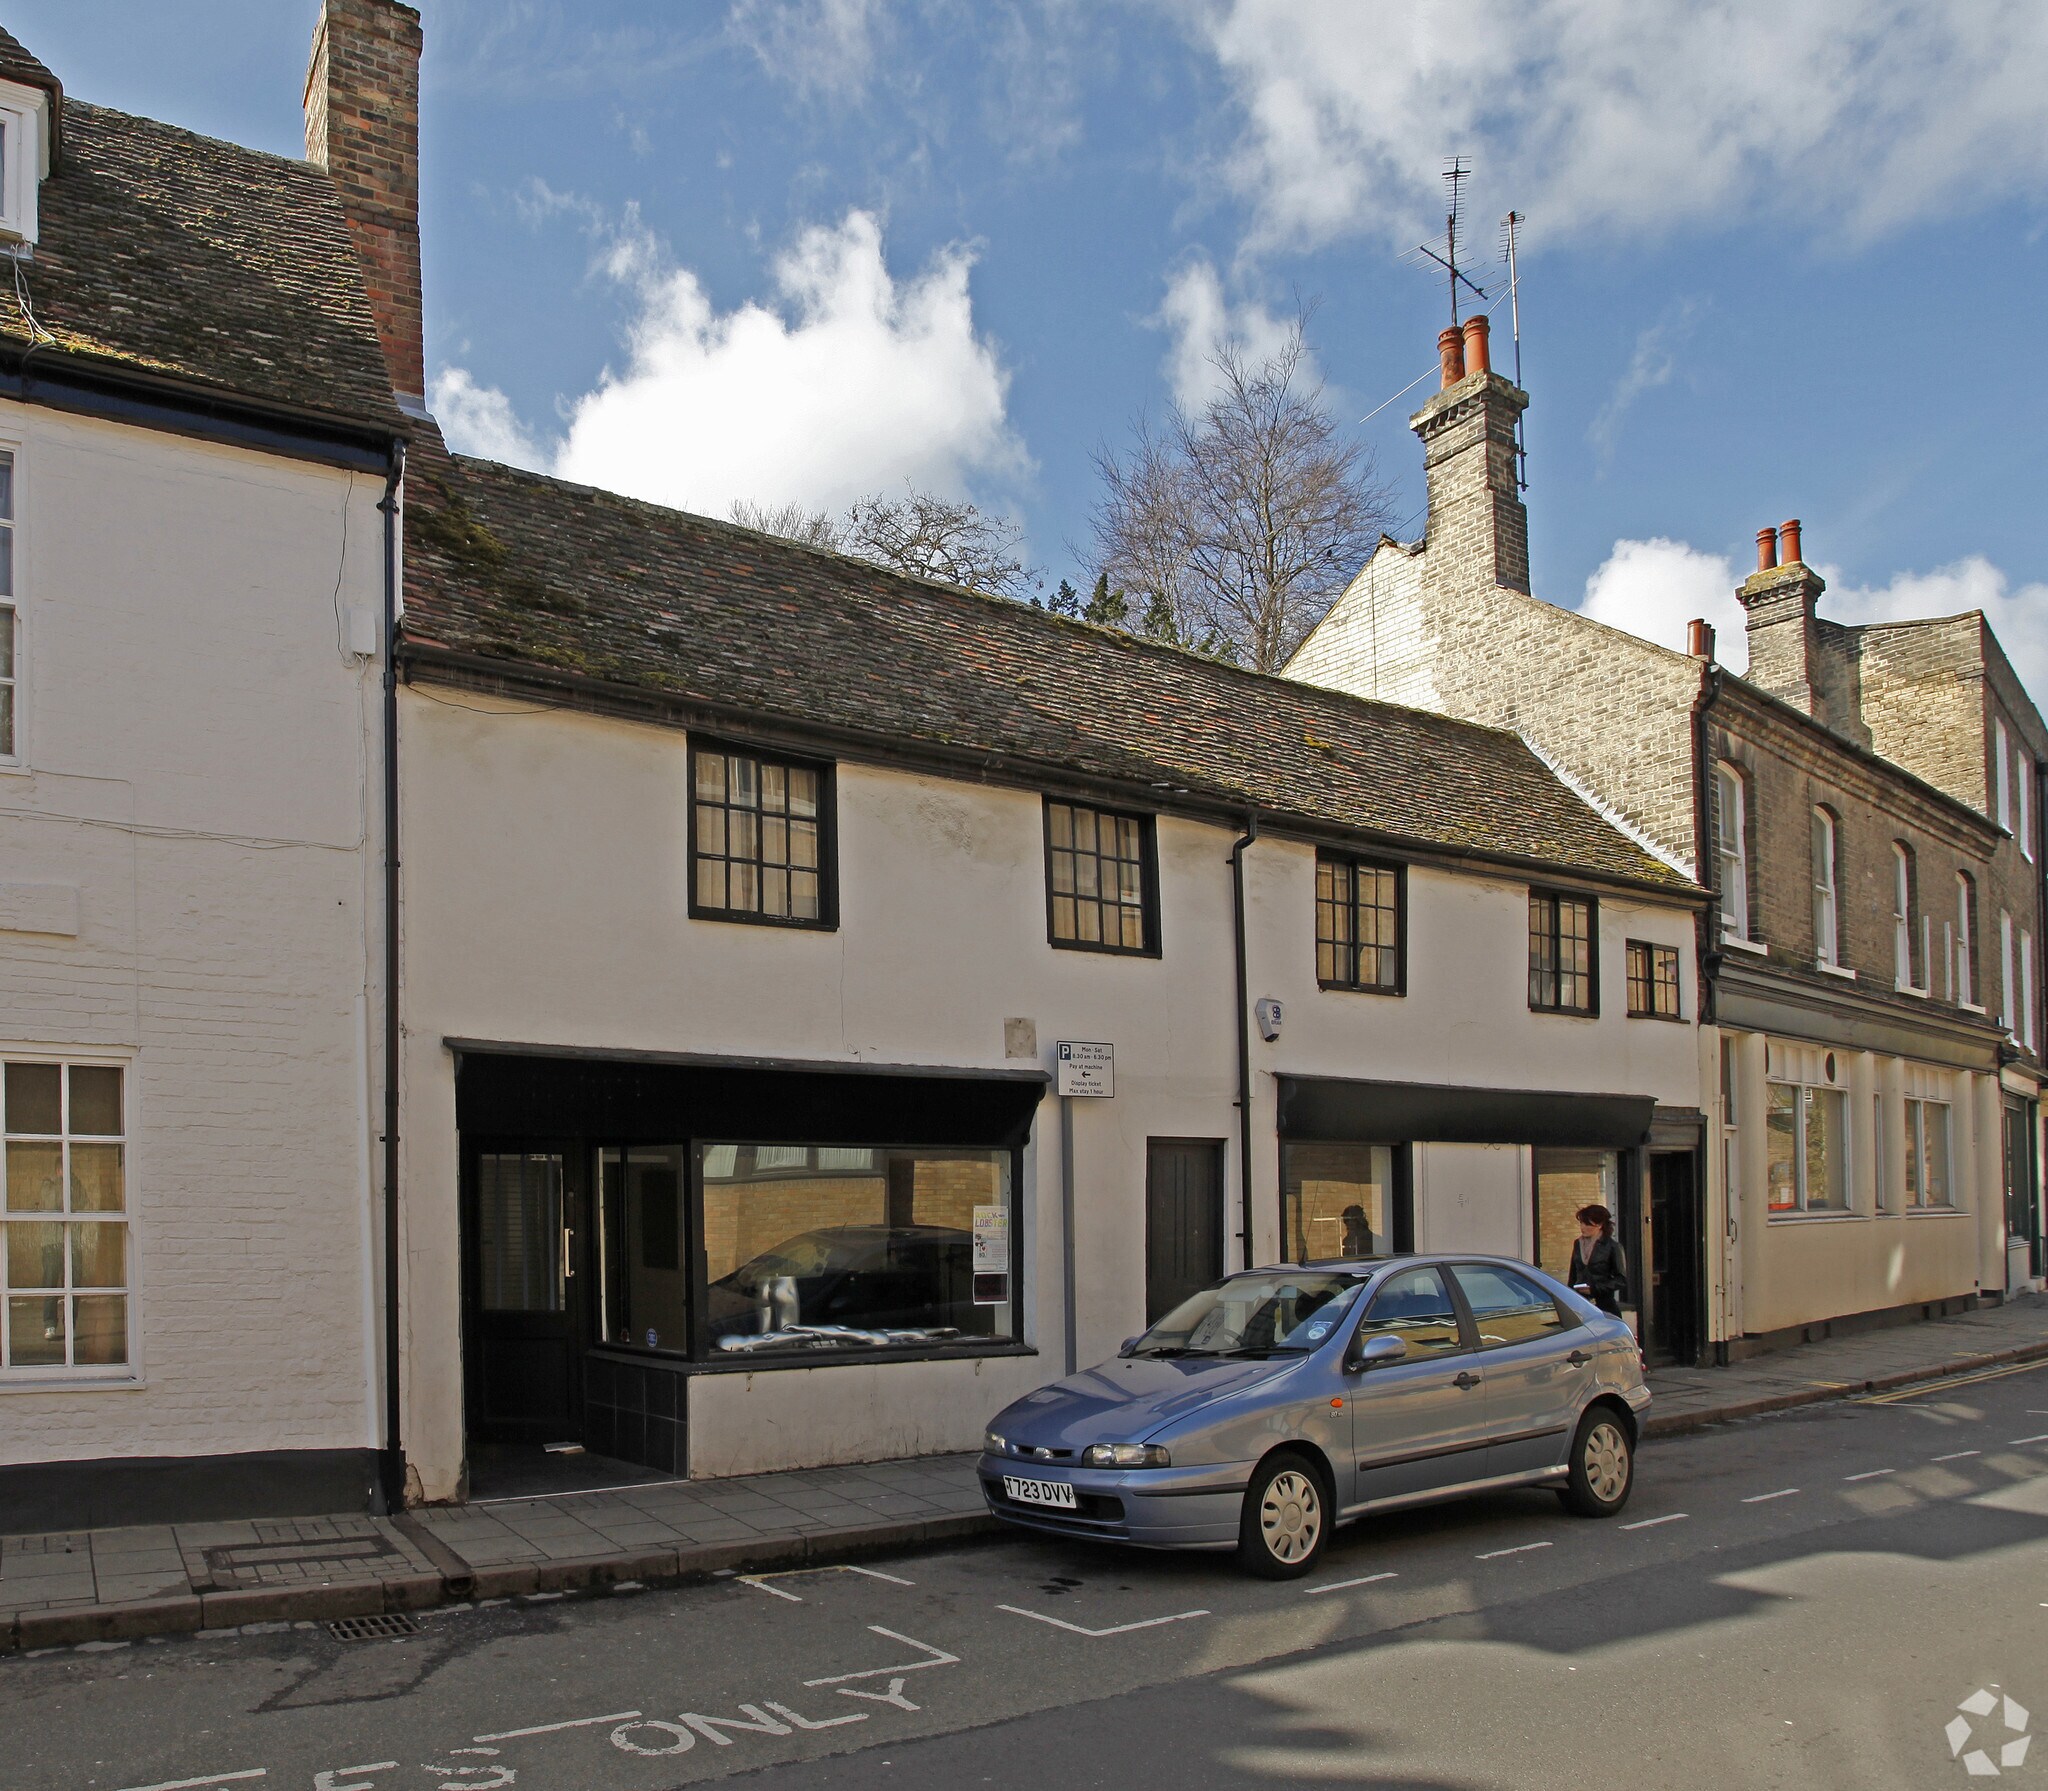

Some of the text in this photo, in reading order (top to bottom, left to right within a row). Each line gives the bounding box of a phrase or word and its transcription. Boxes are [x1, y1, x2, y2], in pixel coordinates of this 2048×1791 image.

[1061, 1045, 1069, 1058] P
[975, 1219, 1007, 1227] LOBSTER
[1005, 1477, 1071, 1503] T723 DVV
[610, 1678, 921, 1755] ONLY
